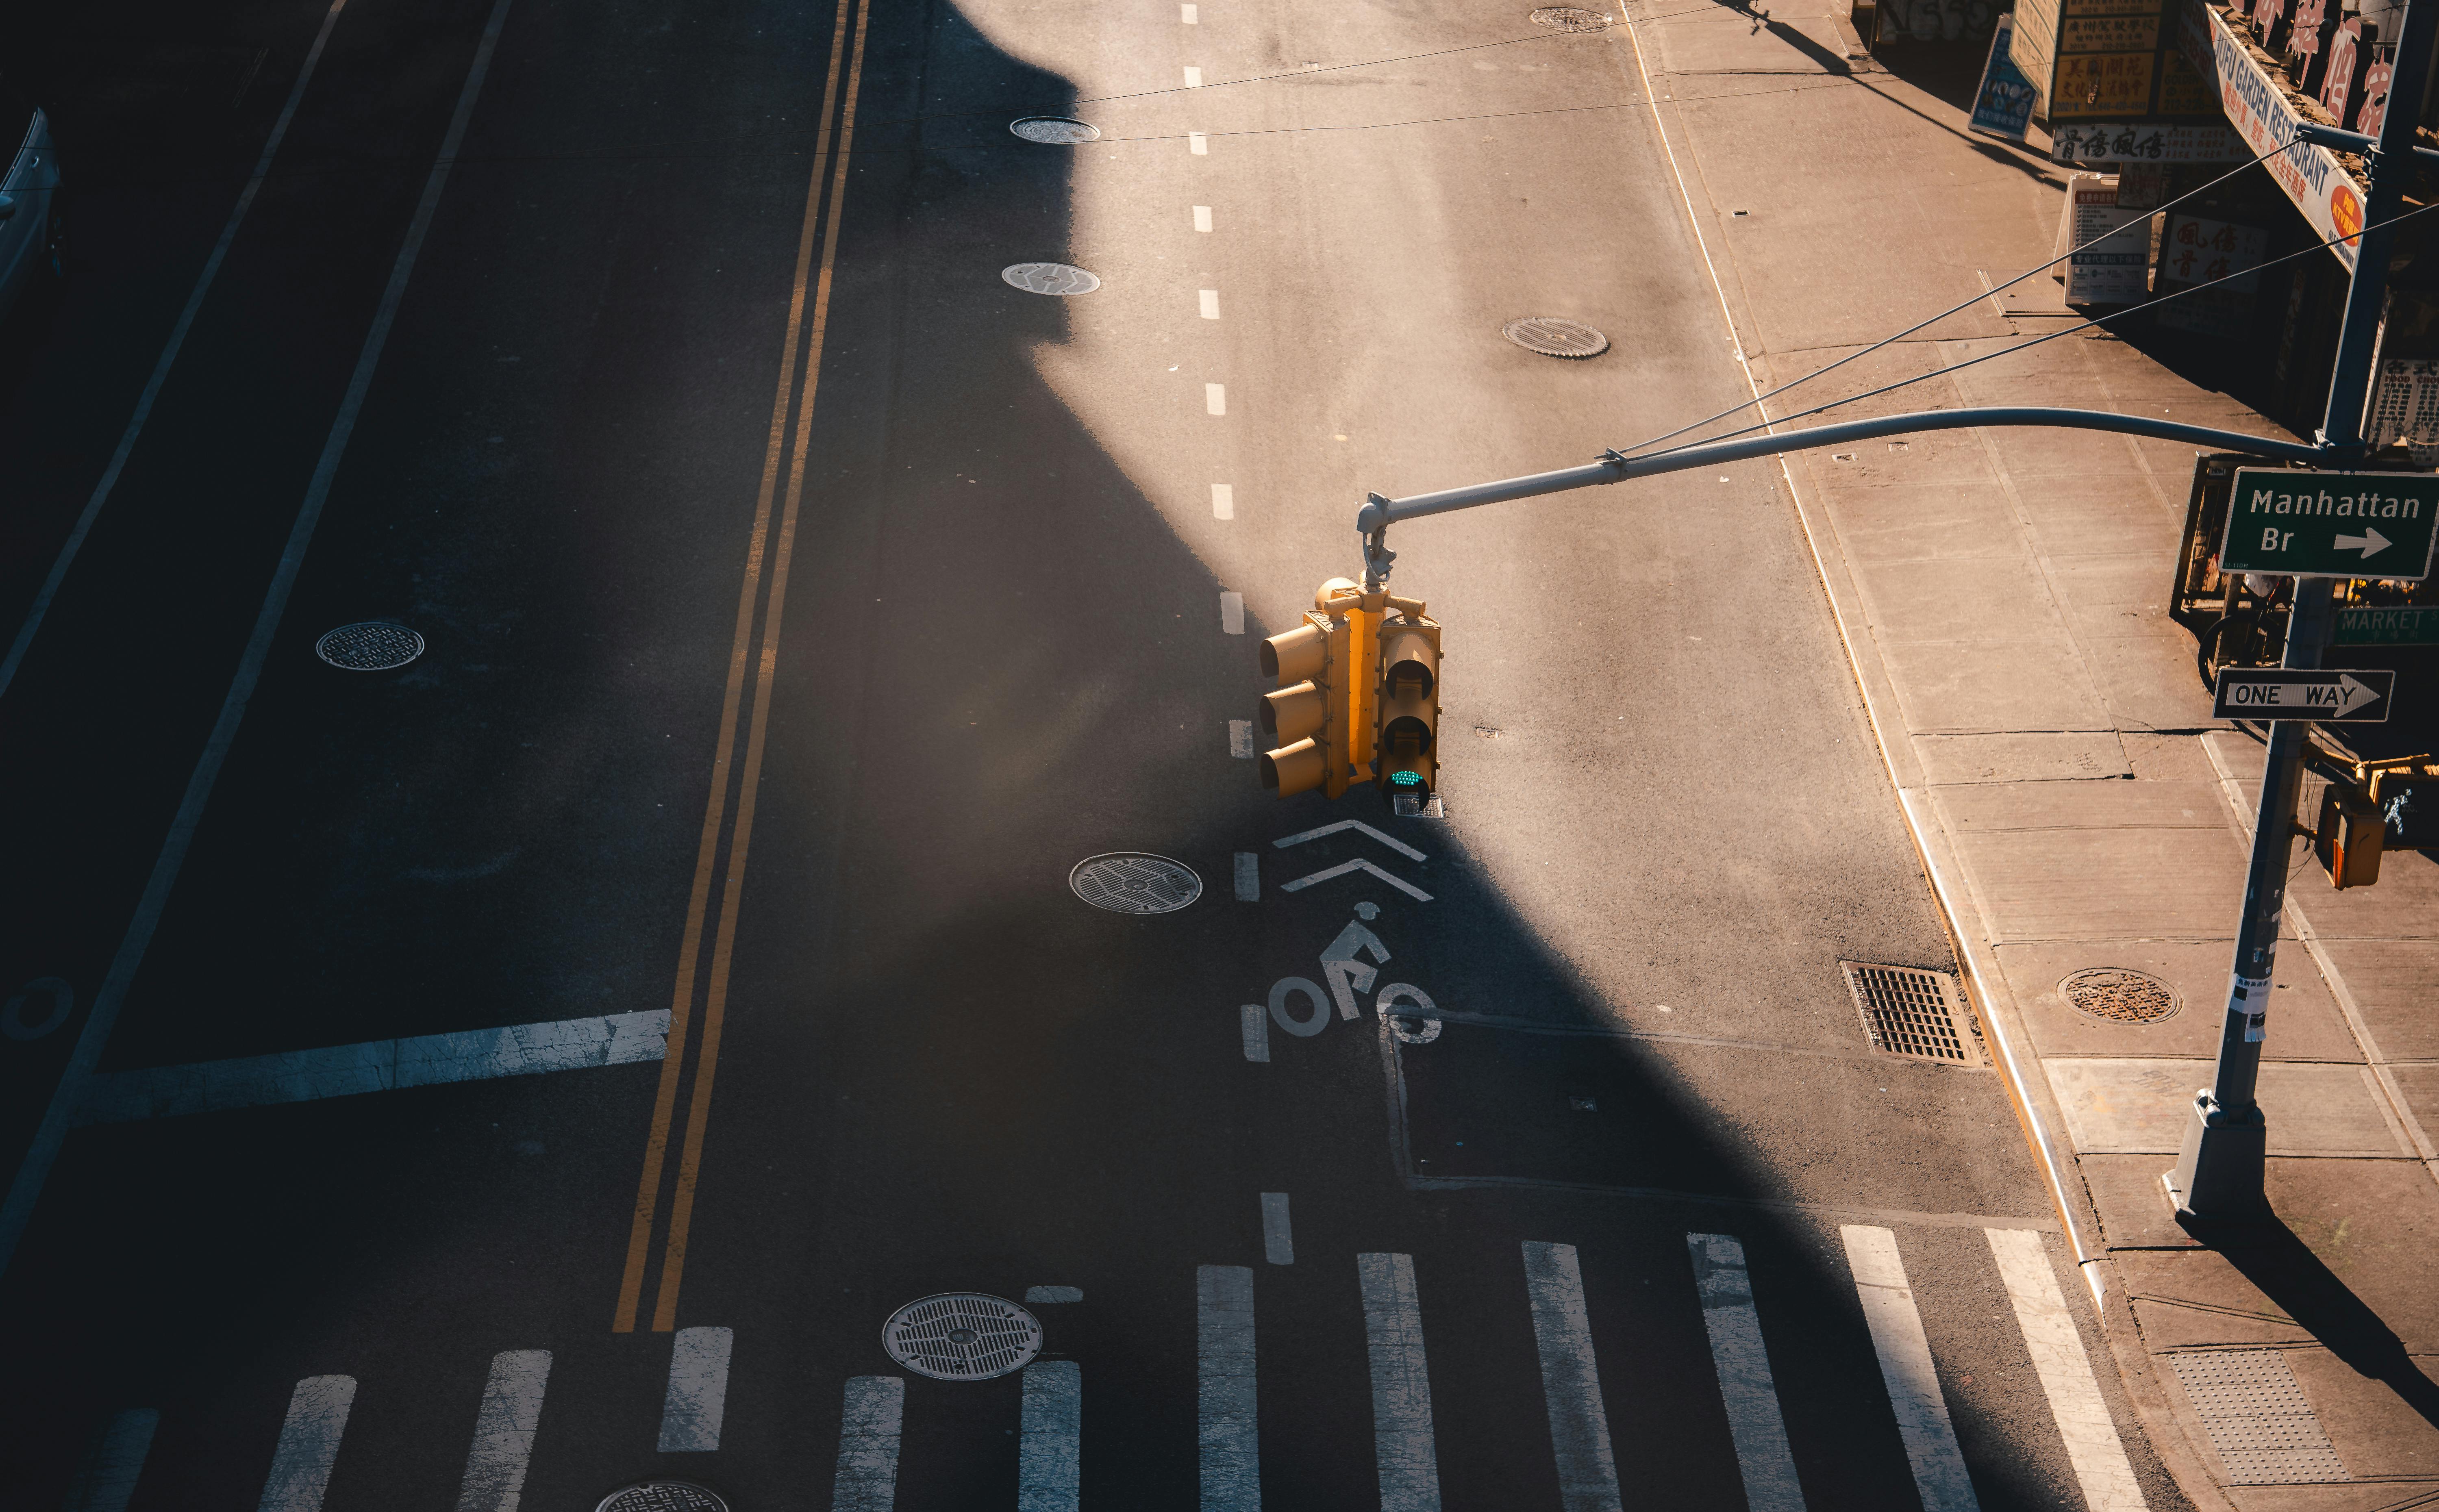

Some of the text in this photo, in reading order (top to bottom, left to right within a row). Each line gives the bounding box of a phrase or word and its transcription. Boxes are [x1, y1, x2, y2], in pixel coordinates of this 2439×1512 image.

[2236, 59, 2272, 126] GARDEN
[2269, 100, 2329, 196] RESTAURANT
[2250, 489, 2419, 518] Manhattan
[2261, 528, 2294, 552] Br
[2341, 610, 2424, 630] MARKET
[2235, 685, 2357, 705] ONE WAY
